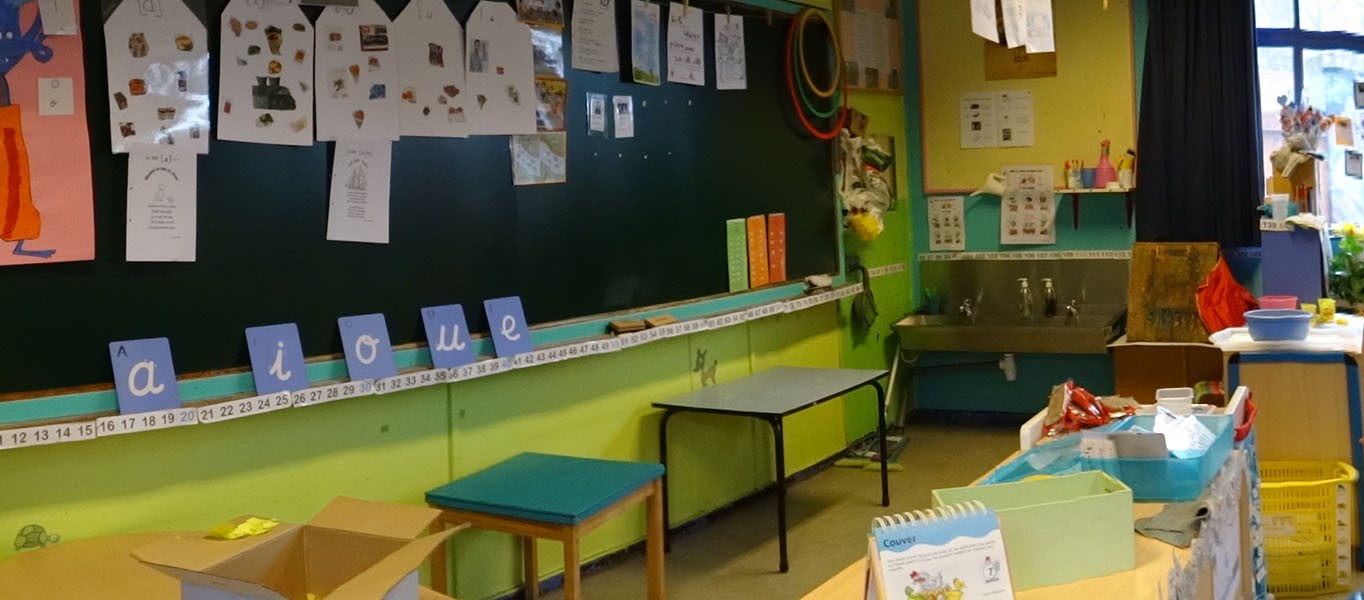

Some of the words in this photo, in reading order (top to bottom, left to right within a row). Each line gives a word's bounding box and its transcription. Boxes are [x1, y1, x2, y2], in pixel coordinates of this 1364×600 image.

[436, 324, 466, 352] u
[501, 315, 521, 341] e
[117, 345, 128, 358] A
[269, 341, 292, 381] i
[355, 334, 380, 365] o
[11, 432, 26, 444] 12
[34, 430, 49, 442] 13
[56, 427, 71, 439] 14
[78, 424, 93, 437] 15
[101, 421, 115, 432] 16
[121, 418, 135, 430] 17
[142, 416, 156, 428] 18
[162, 413, 175, 425] 19
[181, 411, 195, 422] 20
[201, 410, 214, 420] 21
[220, 406, 234, 417] 22
[239, 402, 253, 413] 23
[258, 398, 271, 409] 24
[275, 395, 289, 406] 25
[294, 393, 306, 404] 26
[310, 391, 323, 402] 27
[327, 388, 338, 399] 28
[343, 385, 355, 396] 29
[360, 382, 371, 393] 30
[375, 381, 386, 391] 31
[390, 379, 401, 389] 32
[405, 376, 416, 387] 33
[420, 374, 431, 384] 34
[434, 371, 446, 381] 35
[448, 369, 459, 379] 36
[462, 367, 473, 378] 37
[476, 364, 487, 374] 38
[489, 361, 499, 371] 39
[513, 356, 522, 366] 41
[524, 354, 534, 364] 42
[536, 352, 546, 362] 43
[548, 351, 557, 360] 44
[558, 348, 567, 357] 45
[568, 346, 578, 355] 46
[580, 344, 588, 353] 47
[590, 343, 599, 351] 48
[601, 341, 610, 350] 49
[128, 359, 165, 397] a
[883, 535, 917, 549] Couver
